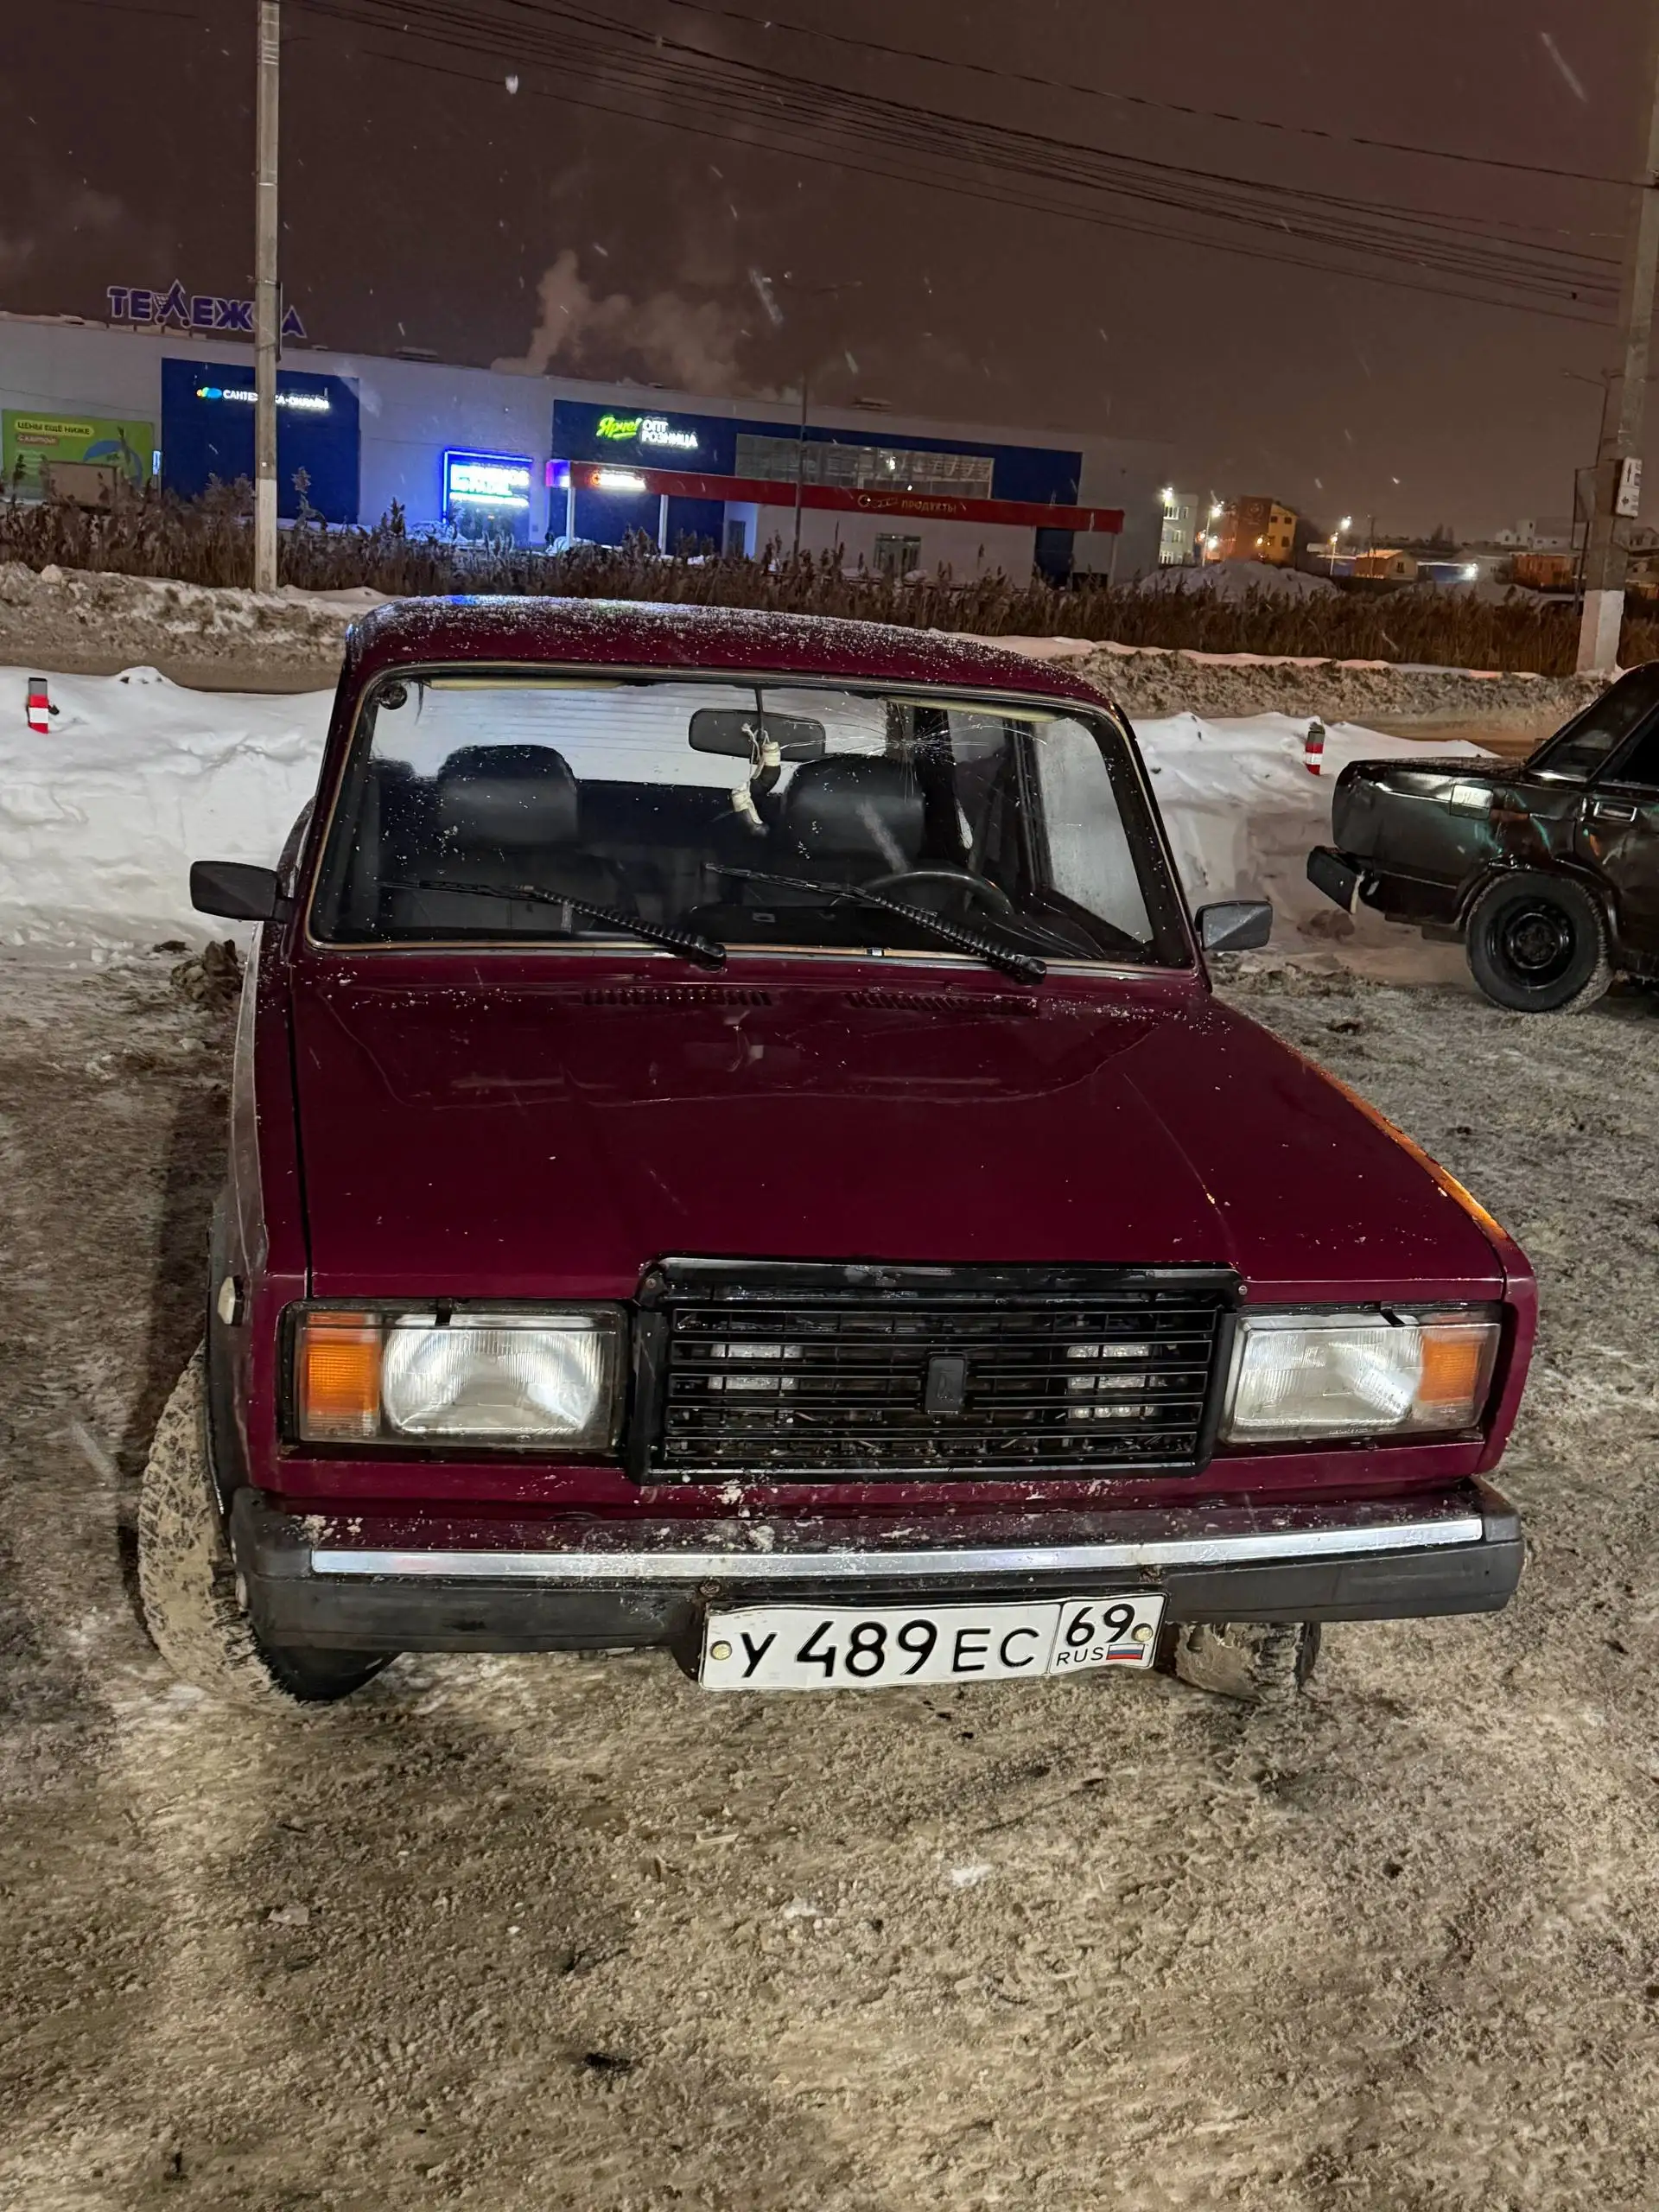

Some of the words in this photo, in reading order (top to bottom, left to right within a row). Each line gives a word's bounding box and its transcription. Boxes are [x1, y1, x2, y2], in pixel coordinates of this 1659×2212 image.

[107, 278, 308, 339] ТЕЛЕЖА
[642, 419, 669, 432] ОПТ
[641, 431, 699, 448] РОЗНИЦА
[901, 499, 957, 514] ПРОДУКТЫ
[1065, 1603, 1136, 1647] 69
[797, 1618, 938, 1678] 489
[1056, 1646, 1104, 1667] RUS
